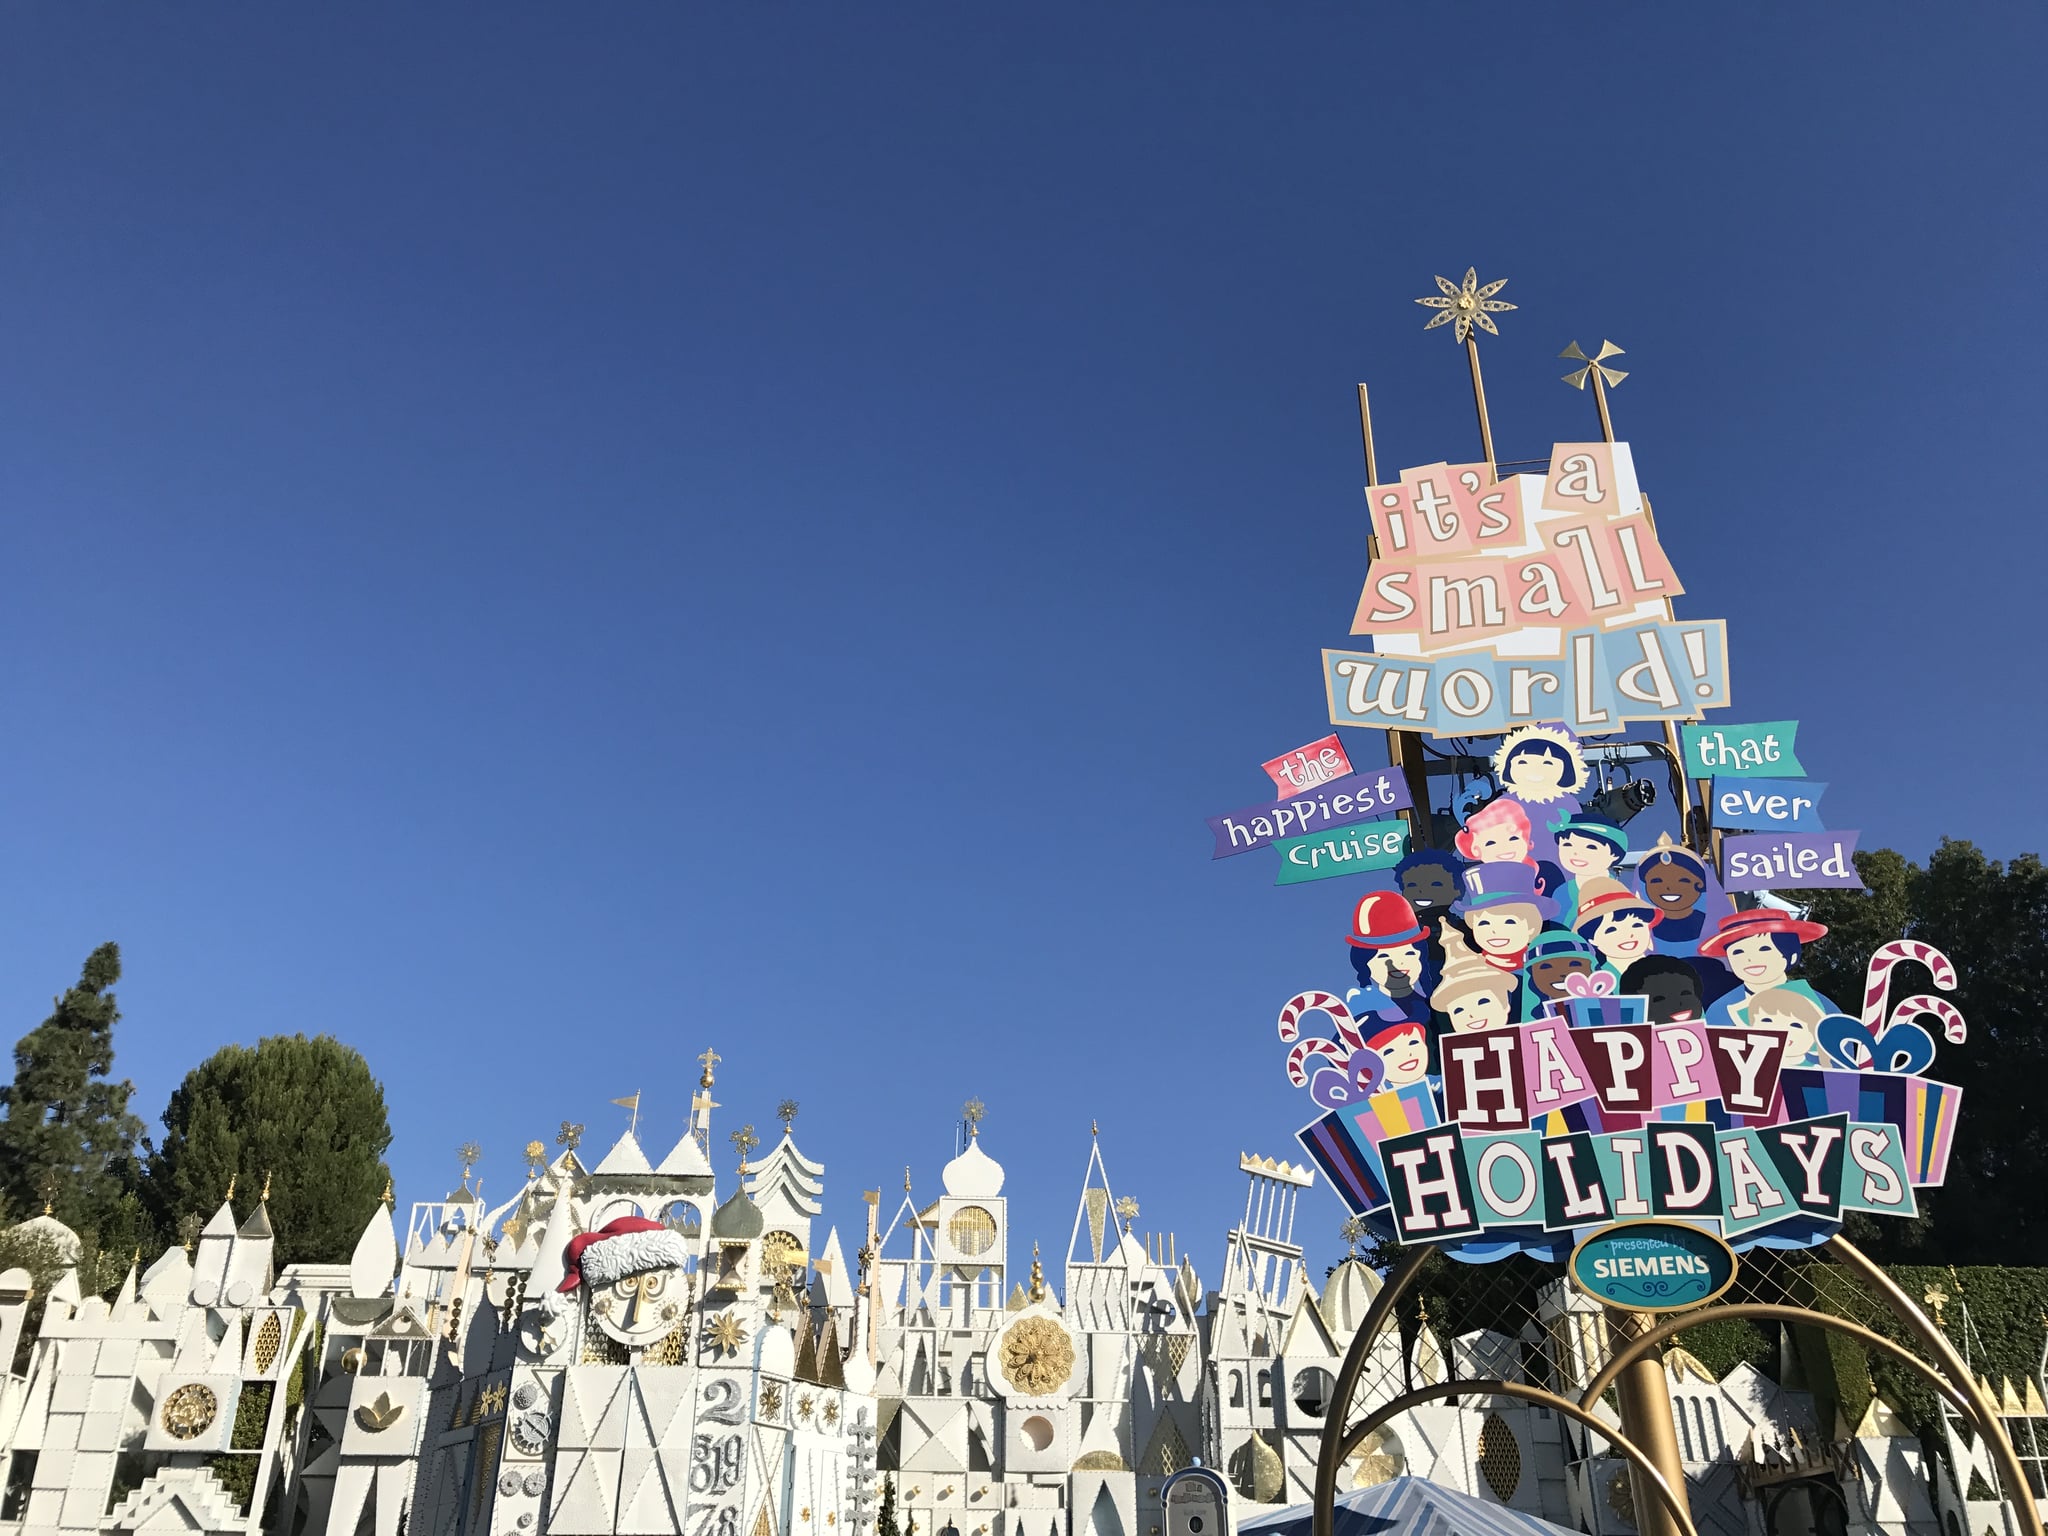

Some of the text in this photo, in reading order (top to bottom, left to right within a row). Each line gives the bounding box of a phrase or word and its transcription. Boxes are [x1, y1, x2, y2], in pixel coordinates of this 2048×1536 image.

[1380, 453, 1606, 552] it's a
[1367, 524, 1665, 635] small
[1335, 628, 1714, 725] world!
[1278, 747, 1341, 787] the
[1697, 731, 1781, 770] that
[1223, 775, 1396, 847] happiest
[1720, 790, 1812, 821] ever
[1288, 830, 1402, 869] cruise
[1729, 842, 1850, 880] sailed
[1452, 1028, 1780, 1124] HAPPY
[1392, 1124, 1905, 1231] HOLIDAYS
[1593, 1255, 1710, 1279] SIEMENS
[1610, 1234, 1669, 1256] presented
[696, 1378, 746, 1426] 2
